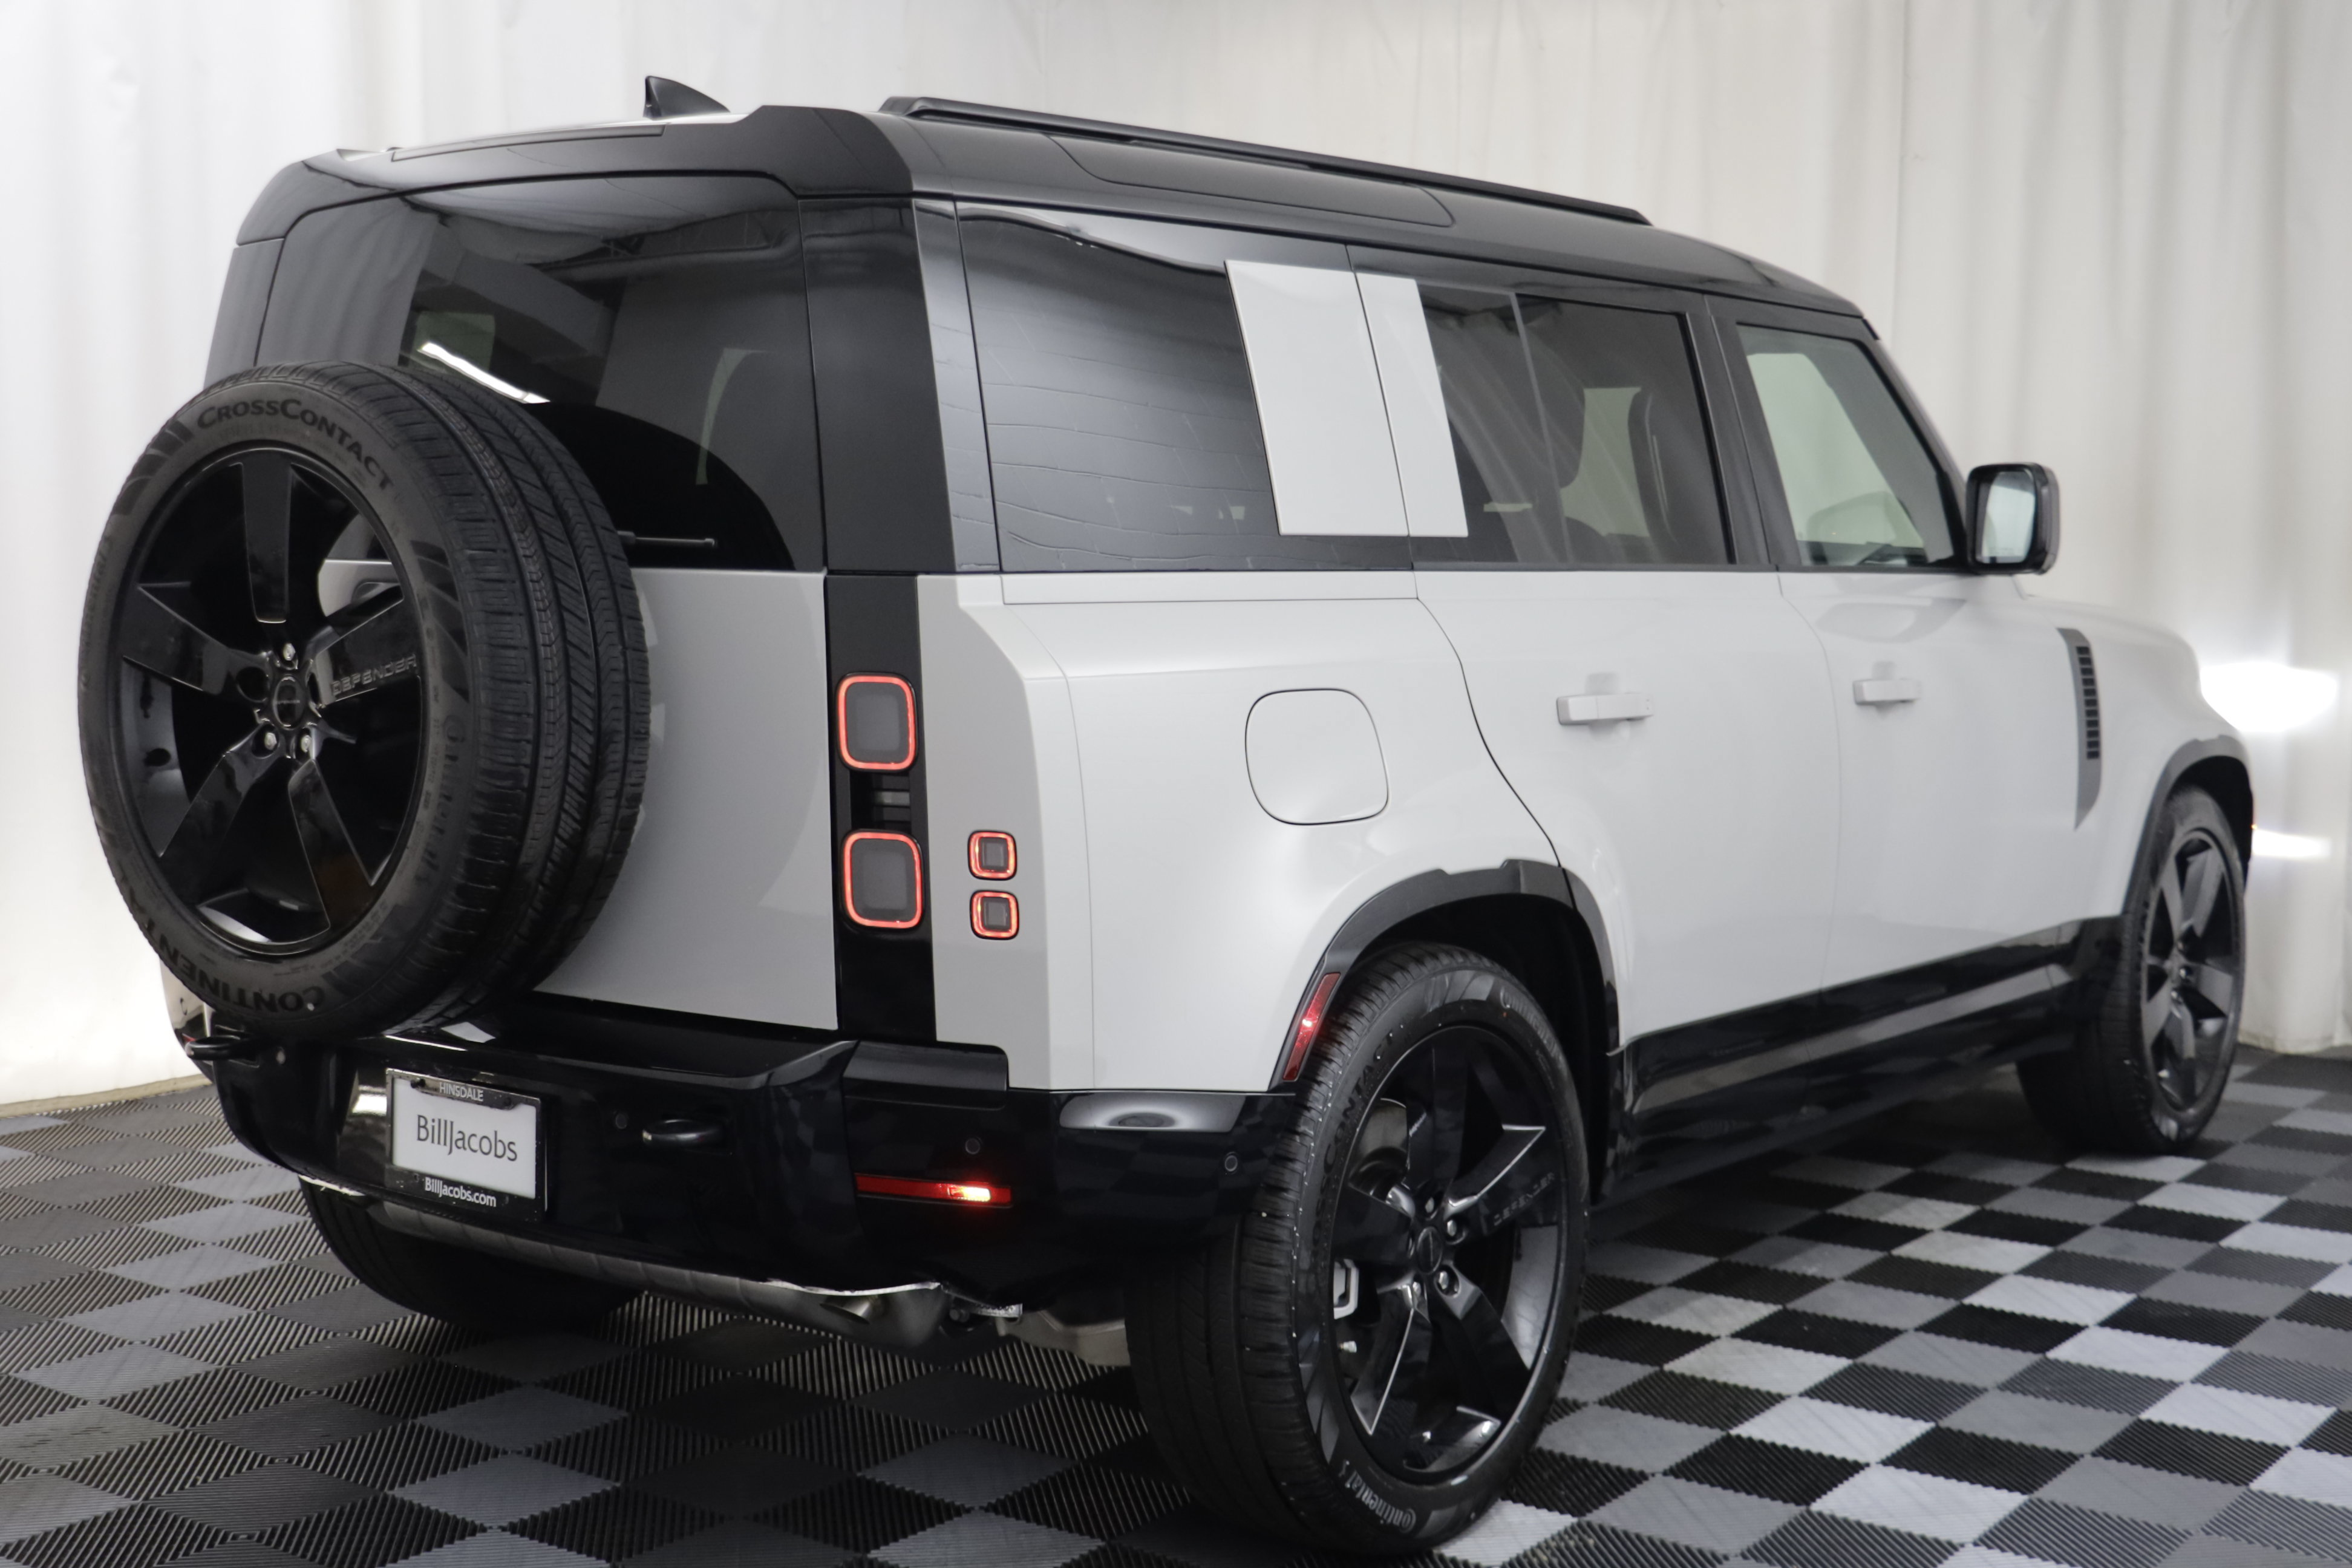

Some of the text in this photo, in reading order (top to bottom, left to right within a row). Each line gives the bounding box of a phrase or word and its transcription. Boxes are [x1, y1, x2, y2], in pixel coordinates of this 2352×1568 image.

[330, 653, 417, 696] DEFENDER
[439, 1082, 484, 1102] HINSDALE
[416, 1114, 518, 1162] BillJacobs
[425, 1177, 497, 1207] BillJacobs.com
